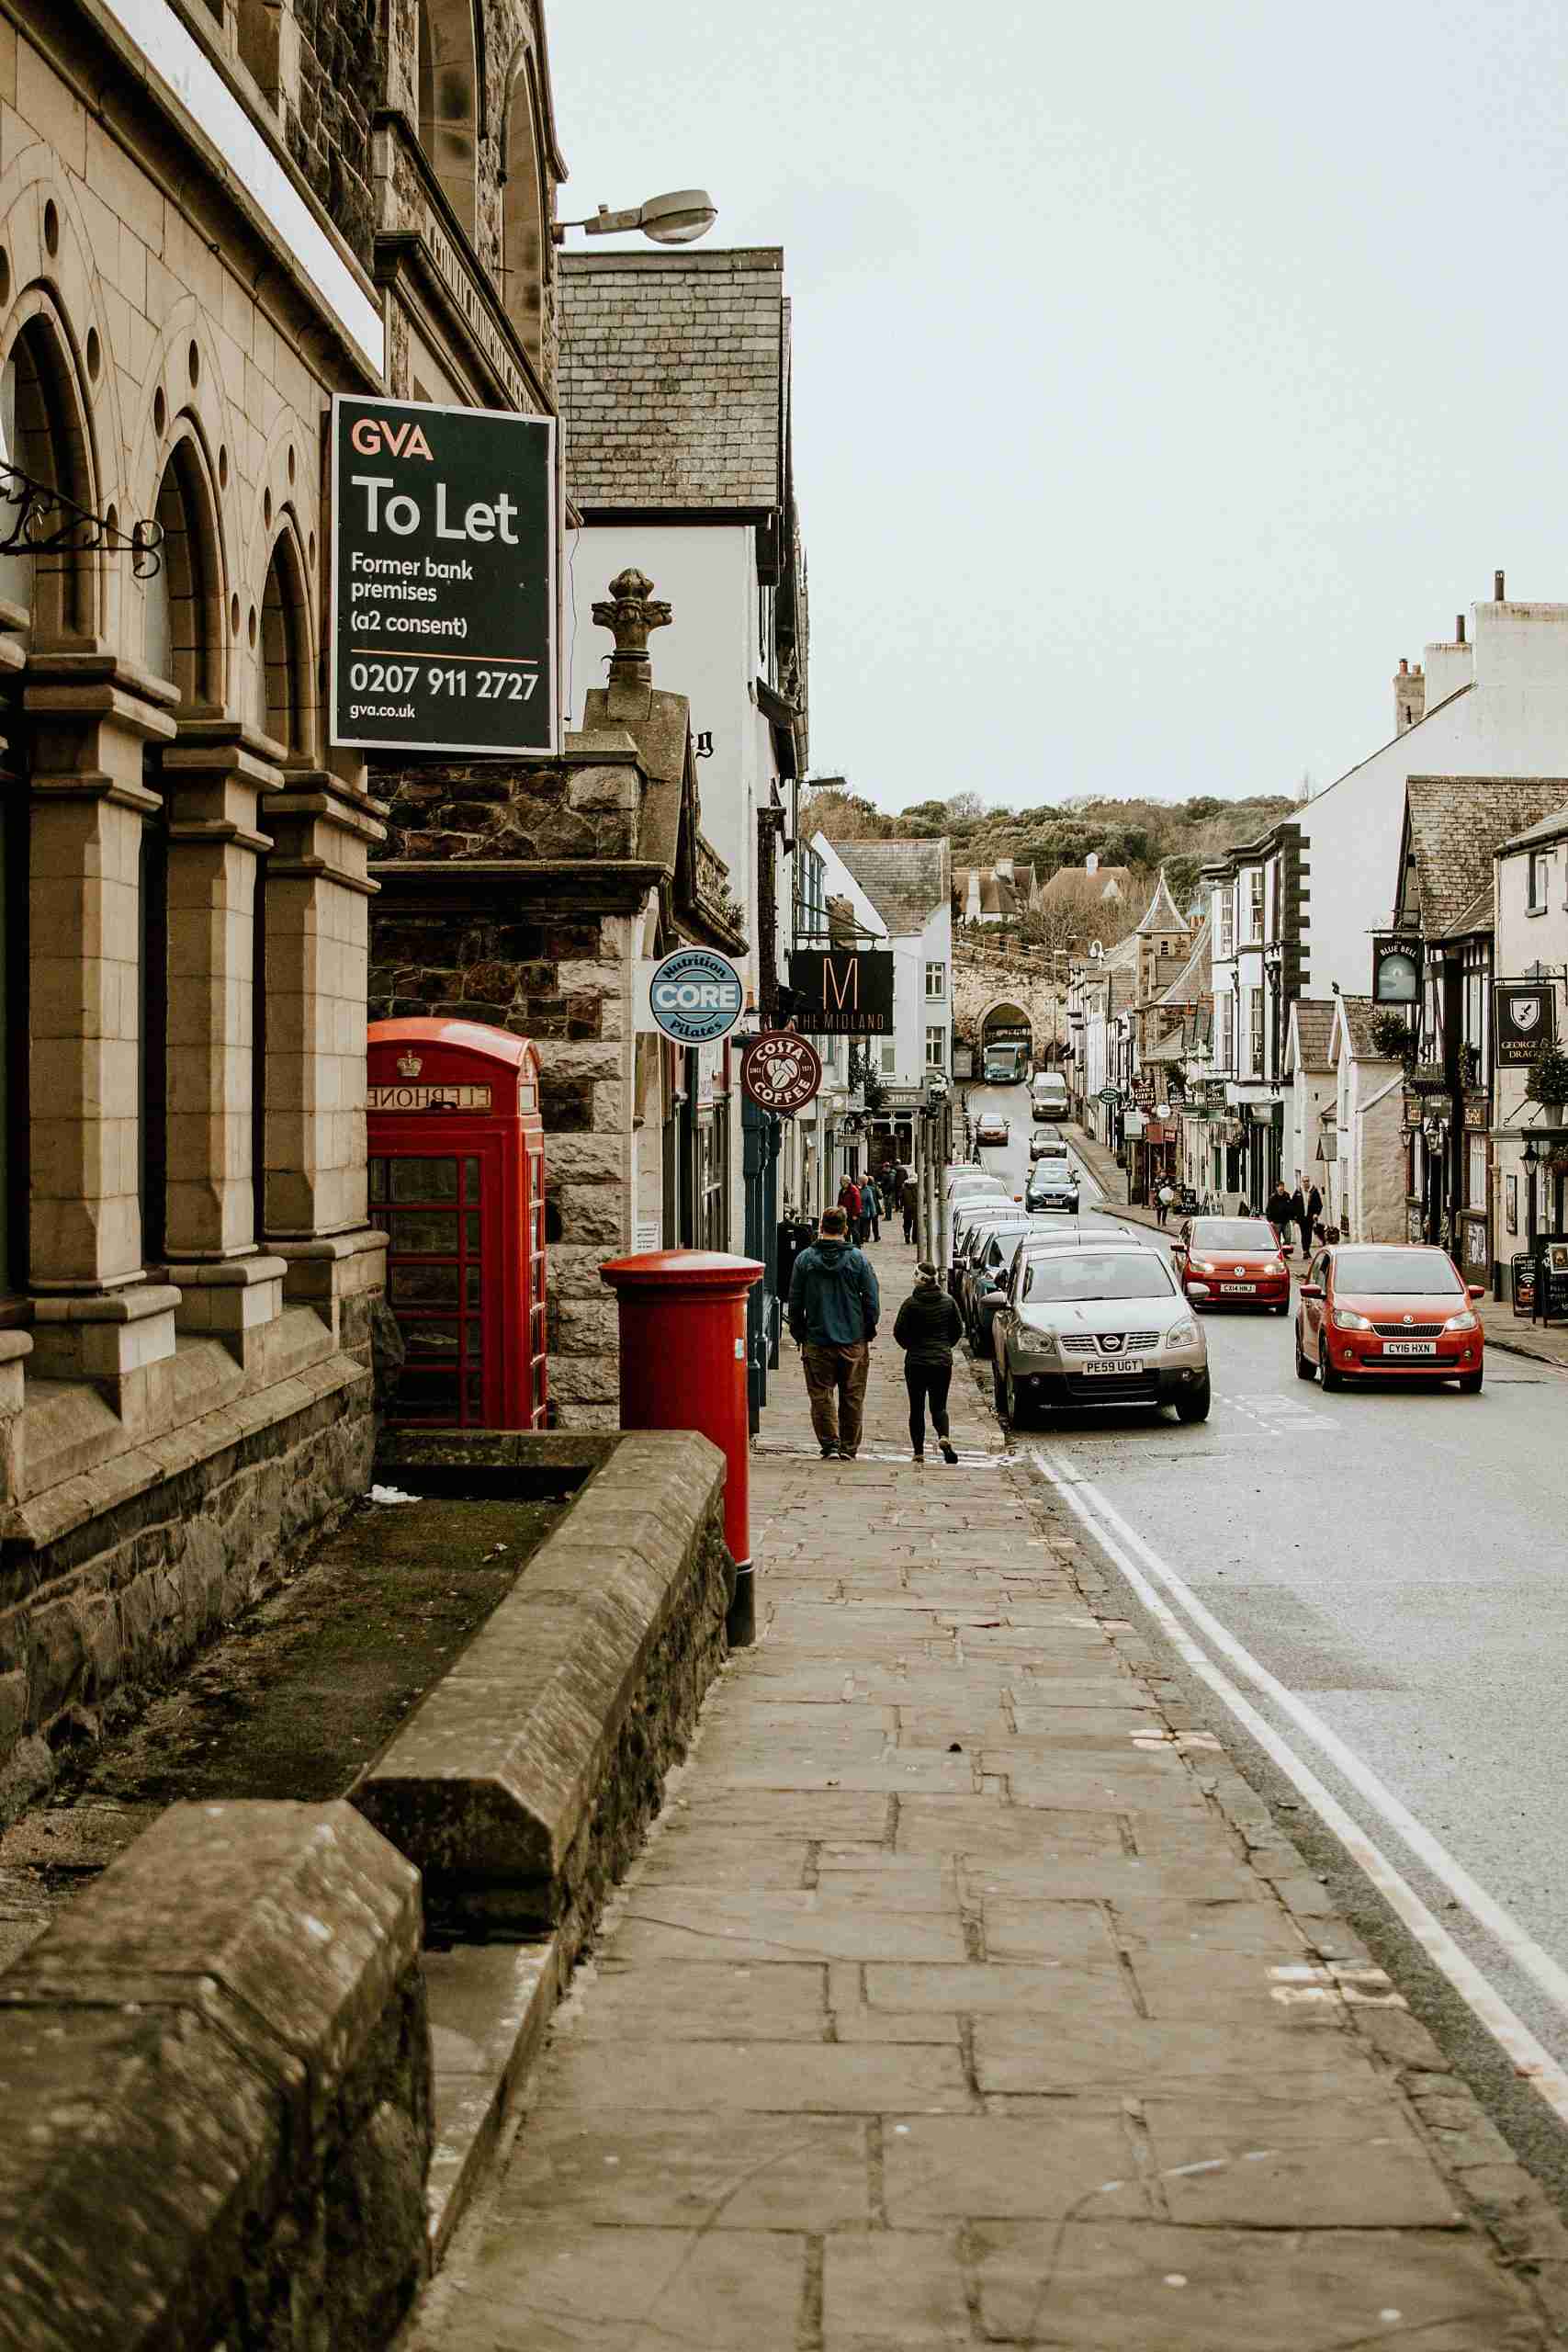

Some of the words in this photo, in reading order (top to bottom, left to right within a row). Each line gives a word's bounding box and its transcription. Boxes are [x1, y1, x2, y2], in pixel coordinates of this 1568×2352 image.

[351, 418, 434, 461] GVA
[351, 475, 421, 536] To
[435, 483, 519, 545] Let
[352, 552, 421, 576] Former
[425, 557, 473, 581] bank
[351, 580, 437, 602] premises
[350, 610, 382, 632] (a2
[386, 616, 468, 639] consent)
[350, 662, 420, 693] 0207
[427, 668, 467, 697] 911
[476, 671, 539, 701] 2727
[350, 703, 416, 719] gva.co.uk
[1380, 945, 1399, 956] BLUE
[1400, 945, 1417, 958] BELL
[662, 955, 728, 979] Nutrition
[822, 957, 859, 1011] M
[656, 984, 737, 1009] CORE
[670, 1020, 723, 1037] Pilates
[824, 1014, 885, 1030] MIDLAND
[756, 1041, 804, 1061] COSTA
[1501, 1041, 1538, 1049] GEORGE
[754, 1079, 811, 1103] COFFEE
[888, 1094, 918, 1103] HIPS
[1389, 1343, 1410, 1353] CY16
[1411, 1343, 1430, 1353] HXN
[1087, 1361, 1115, 1374] PE59
[1117, 1360, 1138, 1372] UGT
